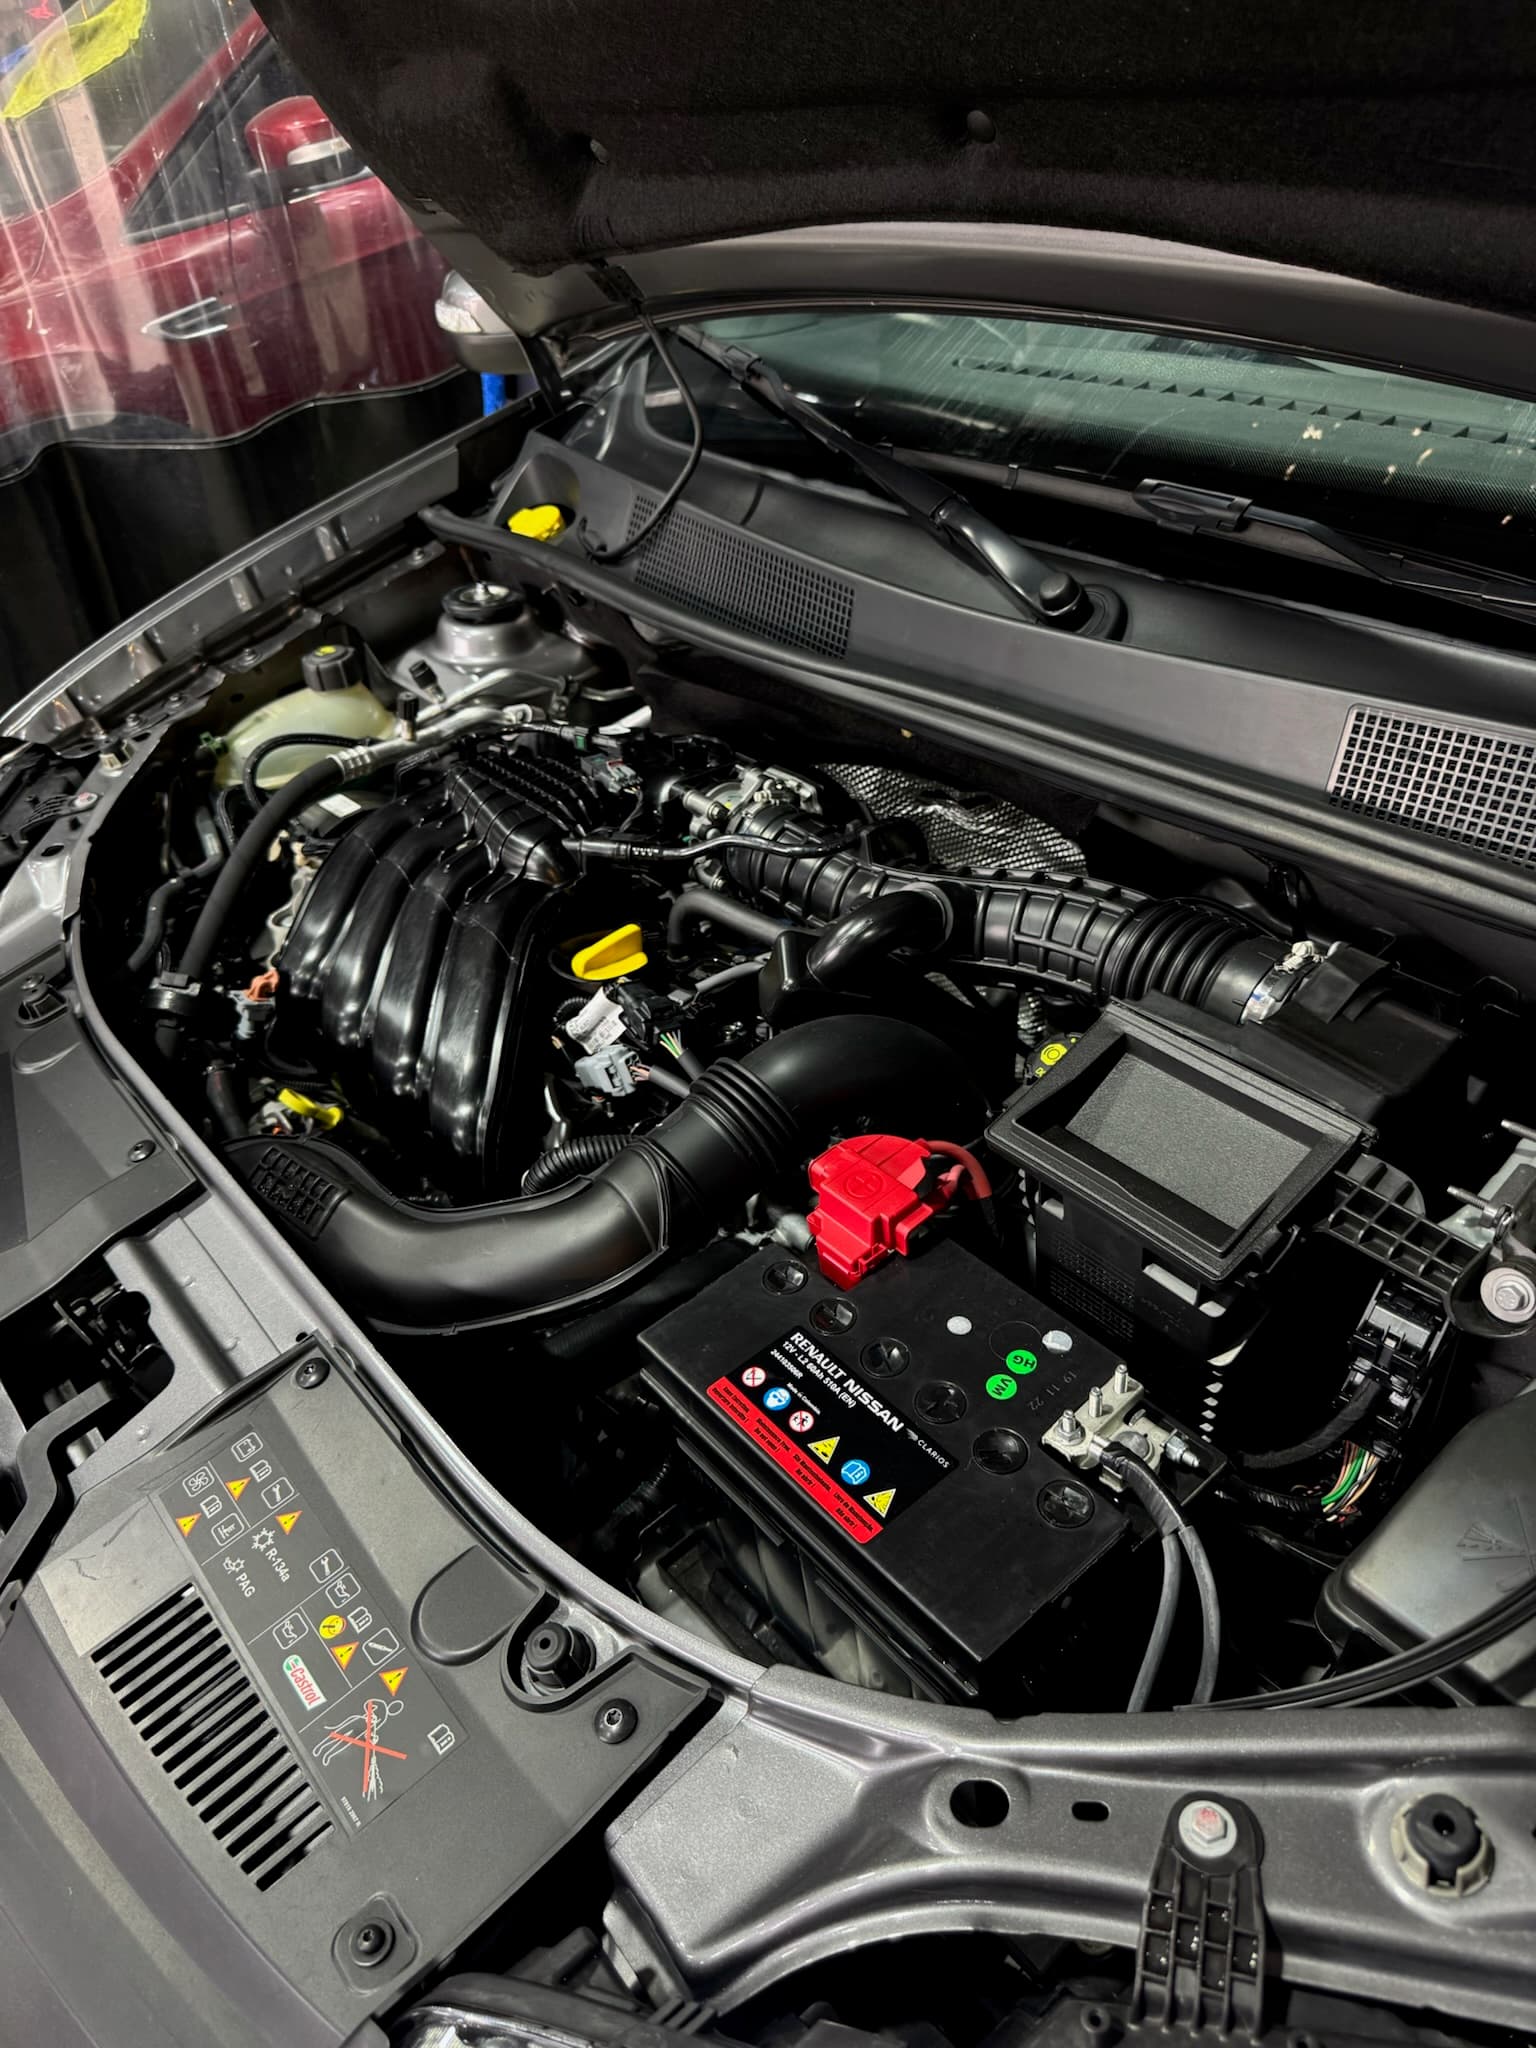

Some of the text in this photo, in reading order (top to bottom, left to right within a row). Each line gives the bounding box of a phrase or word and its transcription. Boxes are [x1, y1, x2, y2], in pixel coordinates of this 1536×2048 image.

[782, 1340, 797, 1354] 12V
[797, 1354, 809, 1365] L2
[806, 1363, 825, 1380] 60Ah
[823, 1377, 842, 1395] 510A
[838, 1392, 857, 1409] (EN)
[1012, 1355, 1036, 1369] HG
[790, 1331, 950, 1468] RENAULT NISSAN CLARIOS
[992, 1377, 1013, 1397] VM
[265, 1547, 290, 1583] R-134a
[235, 1572, 256, 1598] PAG
[290, 1667, 321, 1706] Castrol
